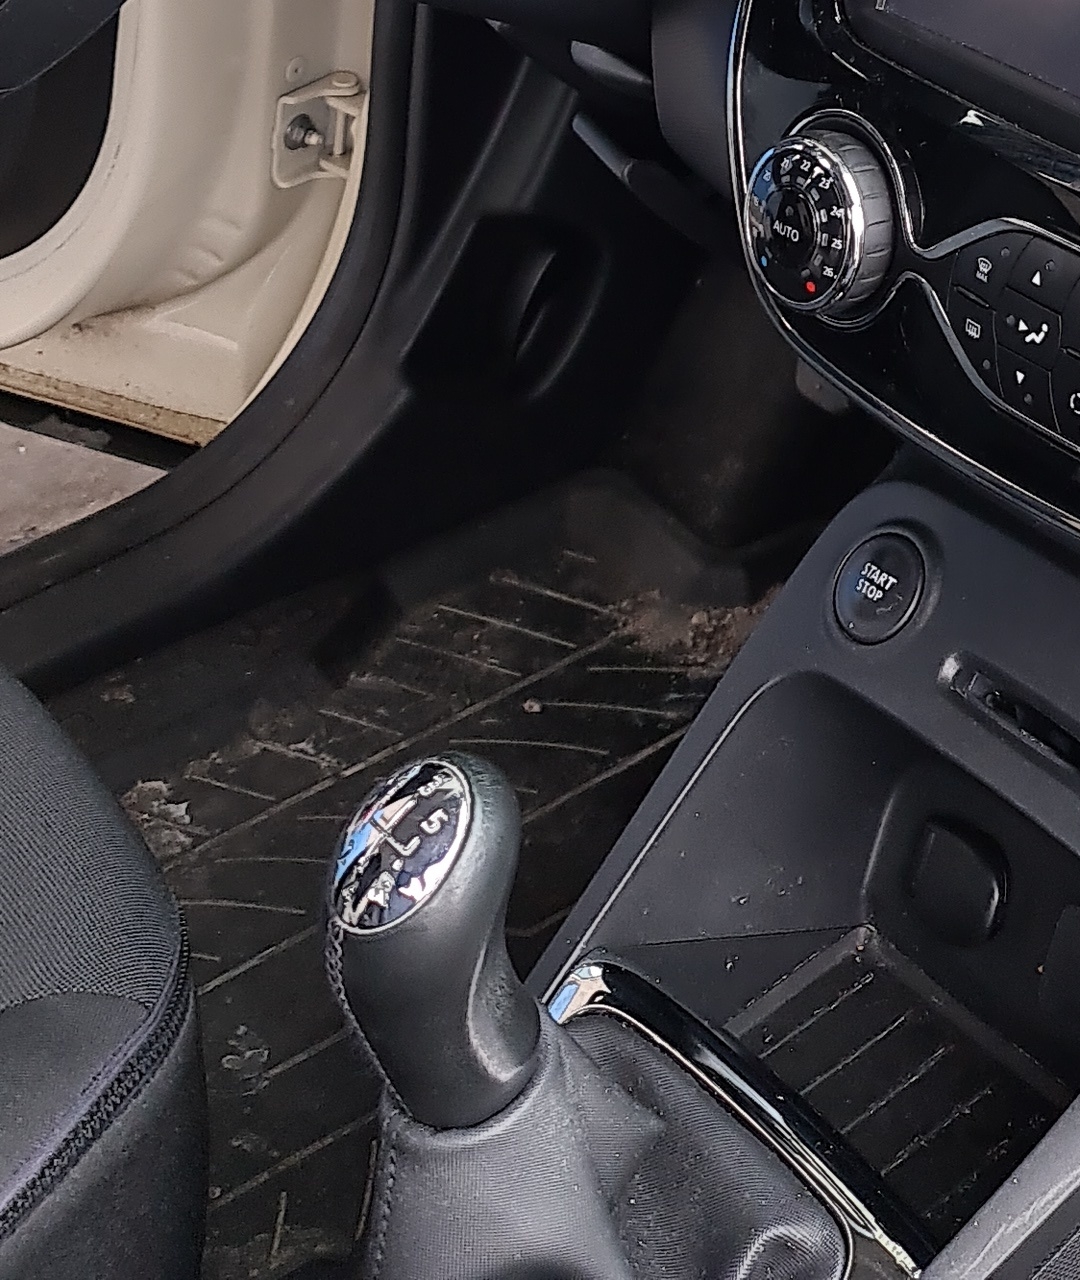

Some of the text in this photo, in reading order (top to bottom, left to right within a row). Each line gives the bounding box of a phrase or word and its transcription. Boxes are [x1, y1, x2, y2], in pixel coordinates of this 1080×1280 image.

[819, 177, 831, 189] 23
[773, 219, 799, 242] AUTO
[831, 238, 843, 250] 25
[860, 562, 898, 591] START
[855, 578, 884, 602] STOP
[418, 807, 450, 835] 5
